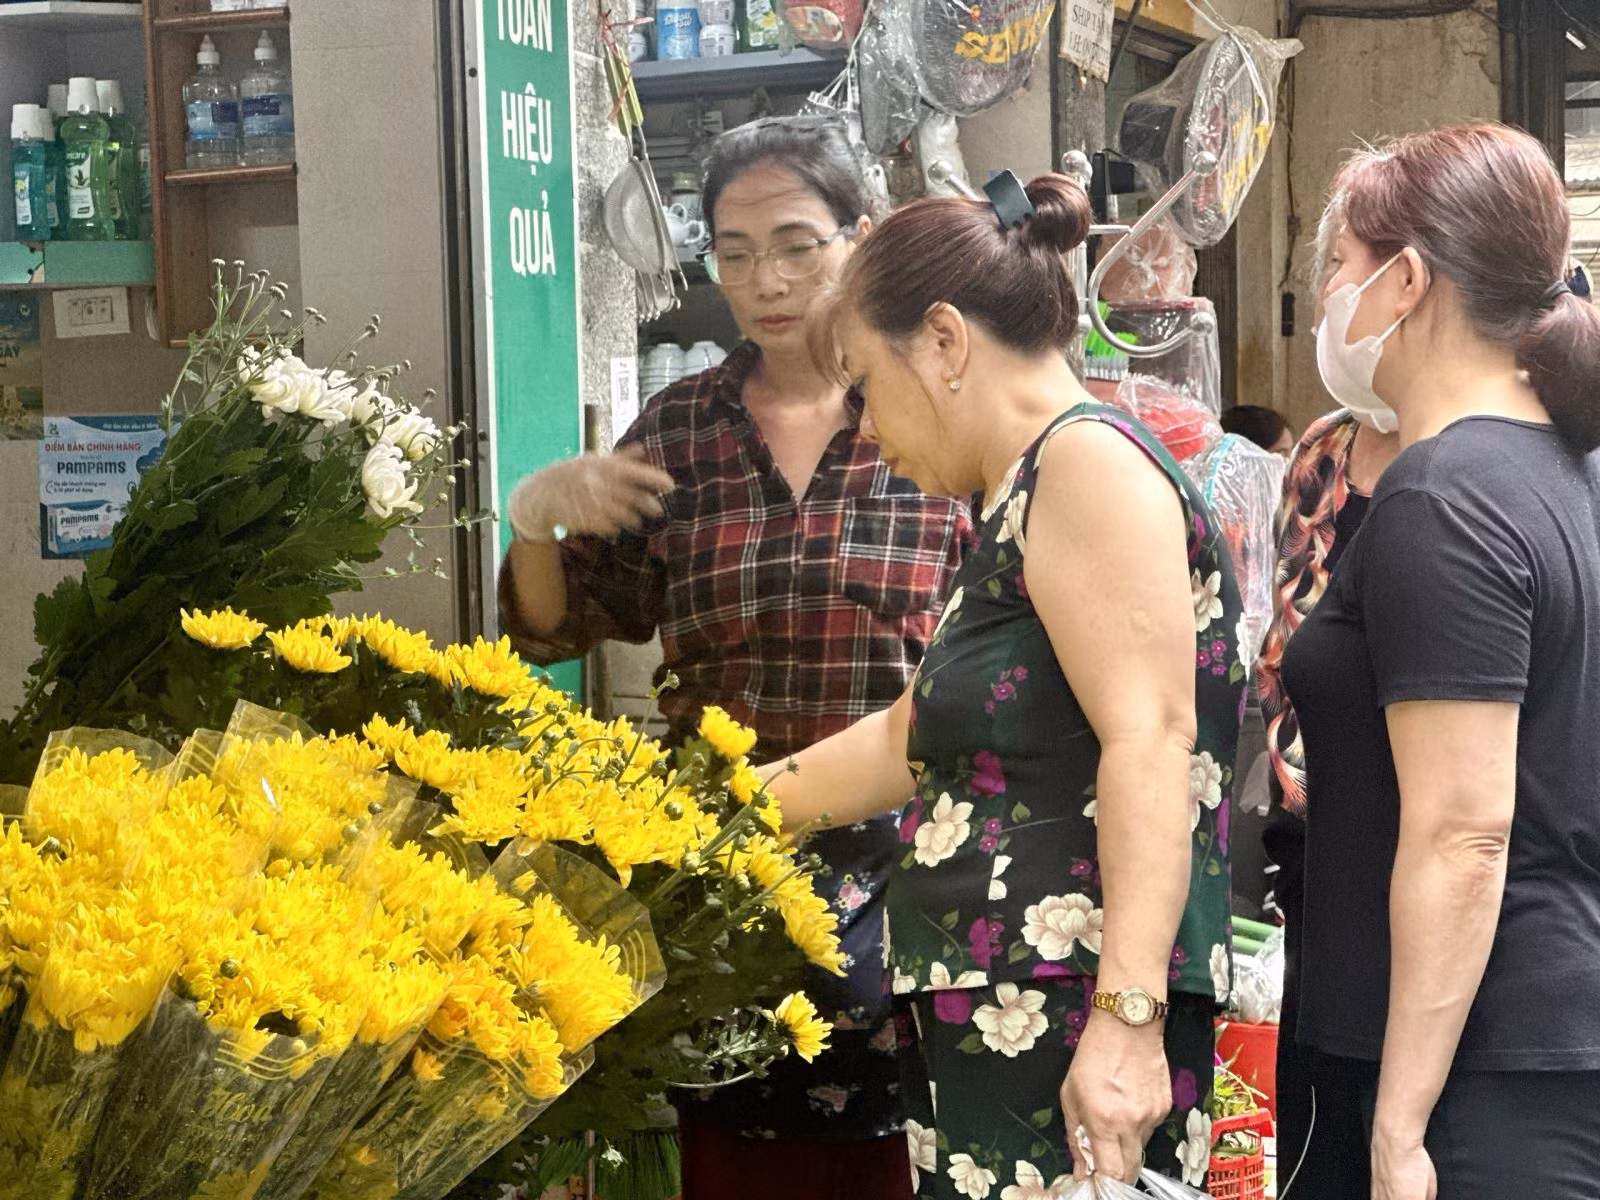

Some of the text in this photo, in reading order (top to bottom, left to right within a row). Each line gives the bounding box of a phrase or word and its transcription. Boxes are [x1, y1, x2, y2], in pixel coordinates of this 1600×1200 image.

[501, 82, 553, 176] HIỆU
[509, 190, 556, 277] QUẢ
[57, 461, 127, 475] PAMPAMS
